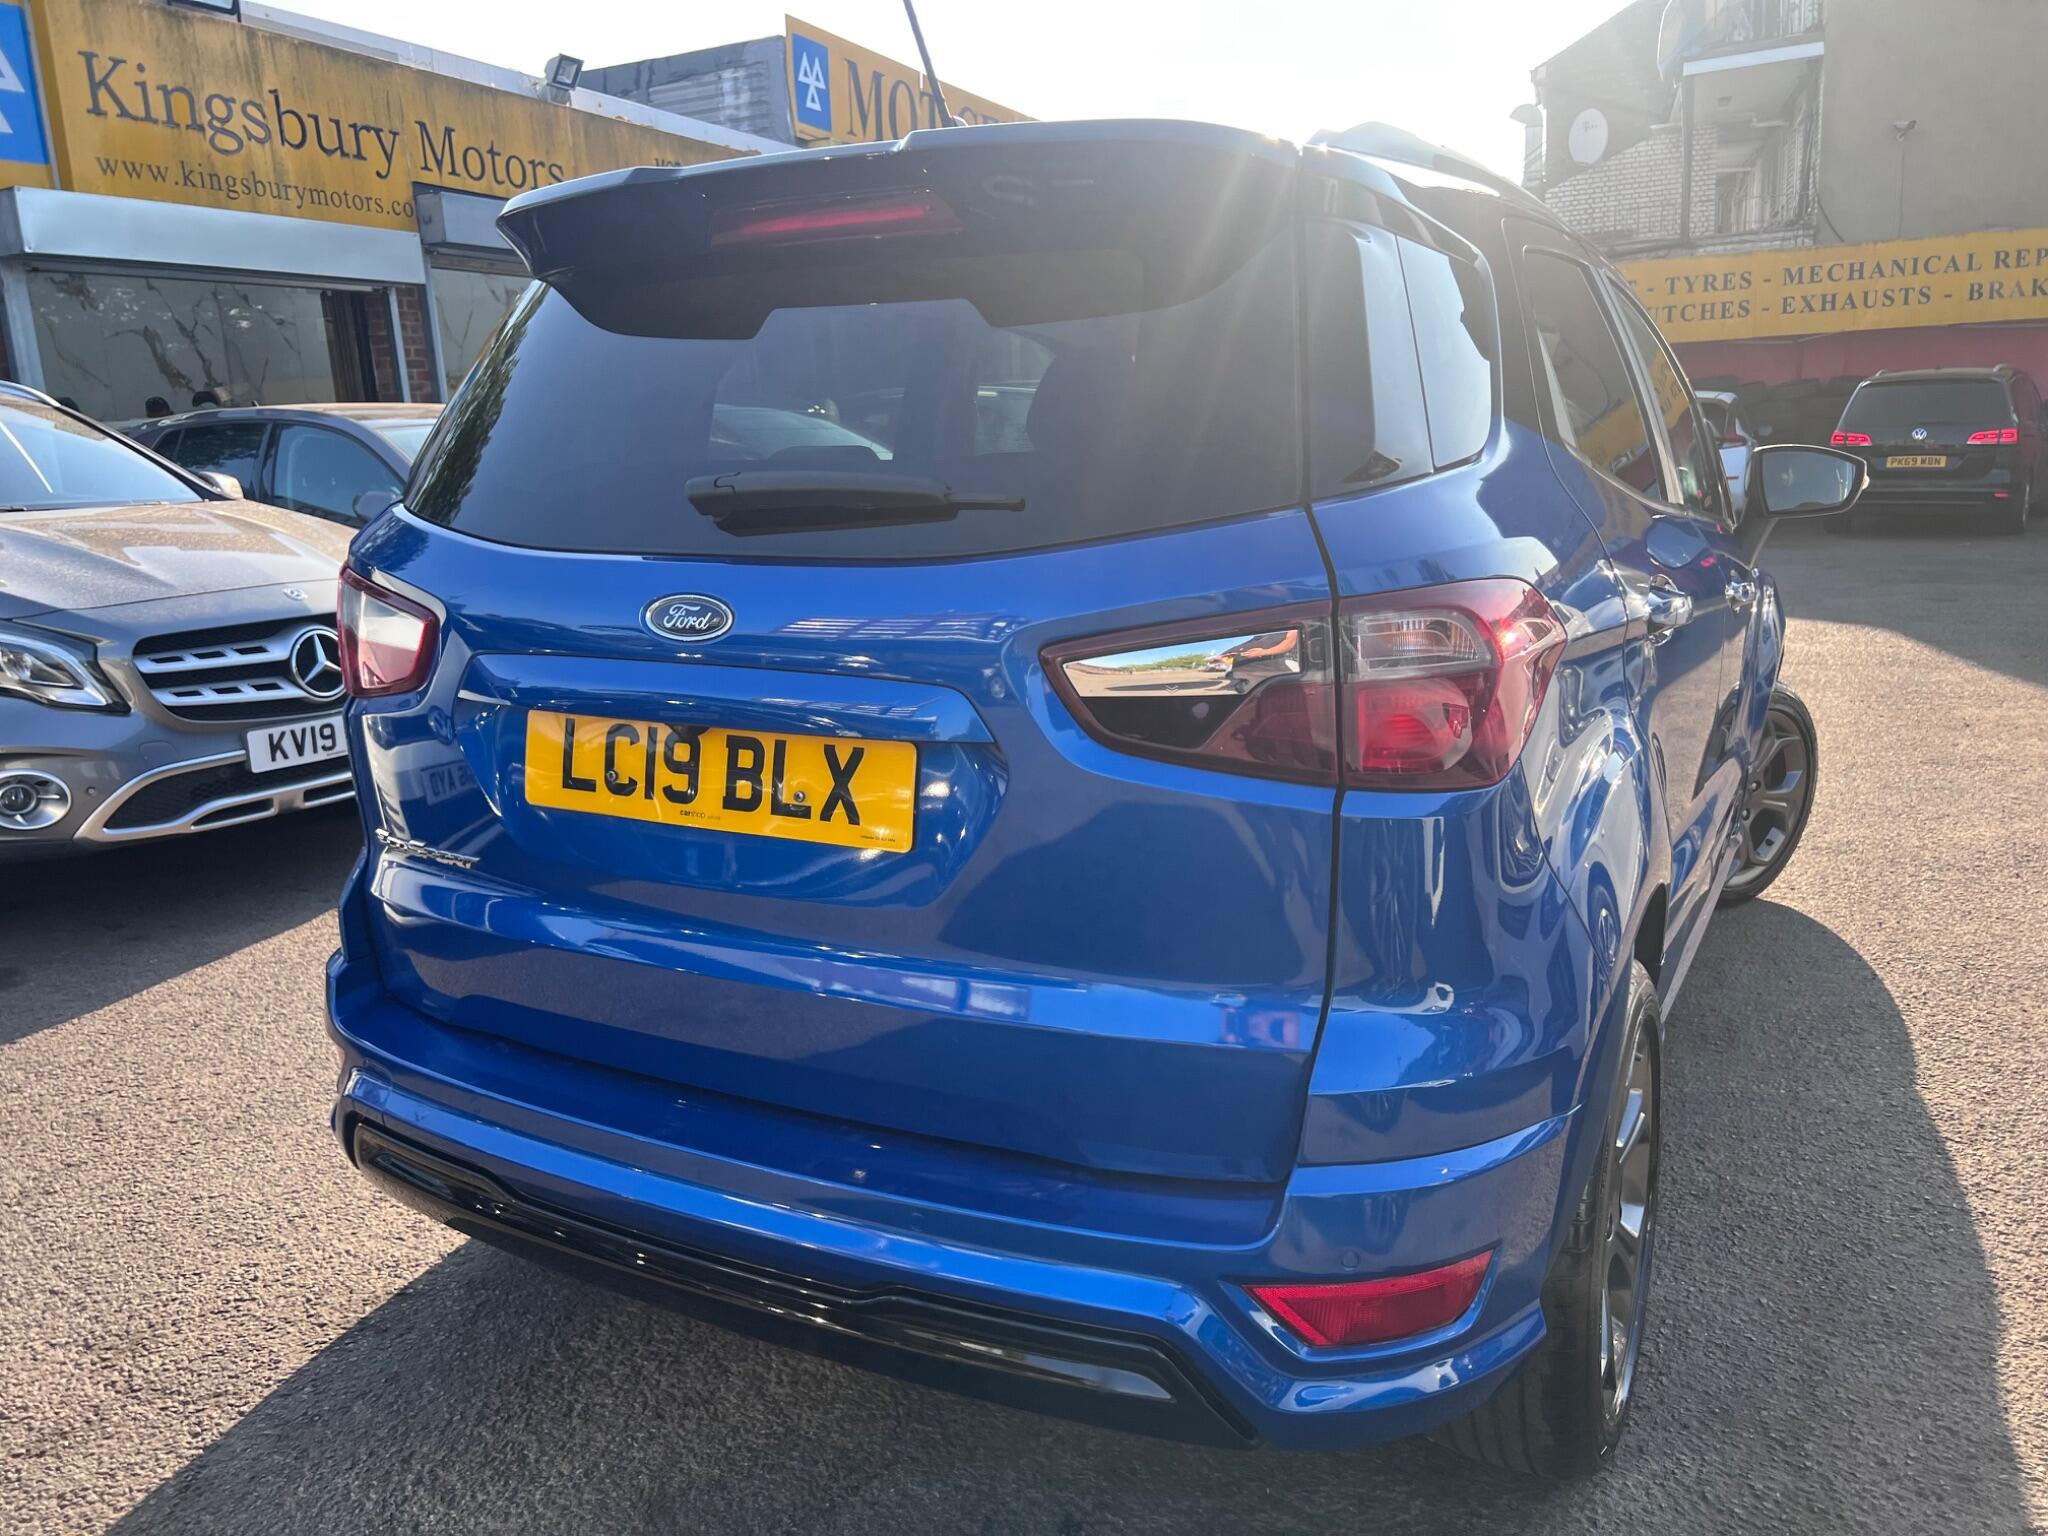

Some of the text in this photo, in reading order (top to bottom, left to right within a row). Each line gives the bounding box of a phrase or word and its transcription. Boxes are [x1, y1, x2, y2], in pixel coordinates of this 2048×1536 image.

[77, 50, 565, 190] Kingsbury Motors
[1665, 271, 1752, 295] TYRES
[1783, 254, 1982, 286] MECHANICAL
[1994, 247, 2048, 270] REP
[1780, 286, 1931, 315] EXHAUSTS
[1968, 277, 2048, 301] BRAK
[663, 603, 712, 630] Ford
[267, 722, 337, 763] KV19
[562, 716, 865, 826] LC19 BLX
